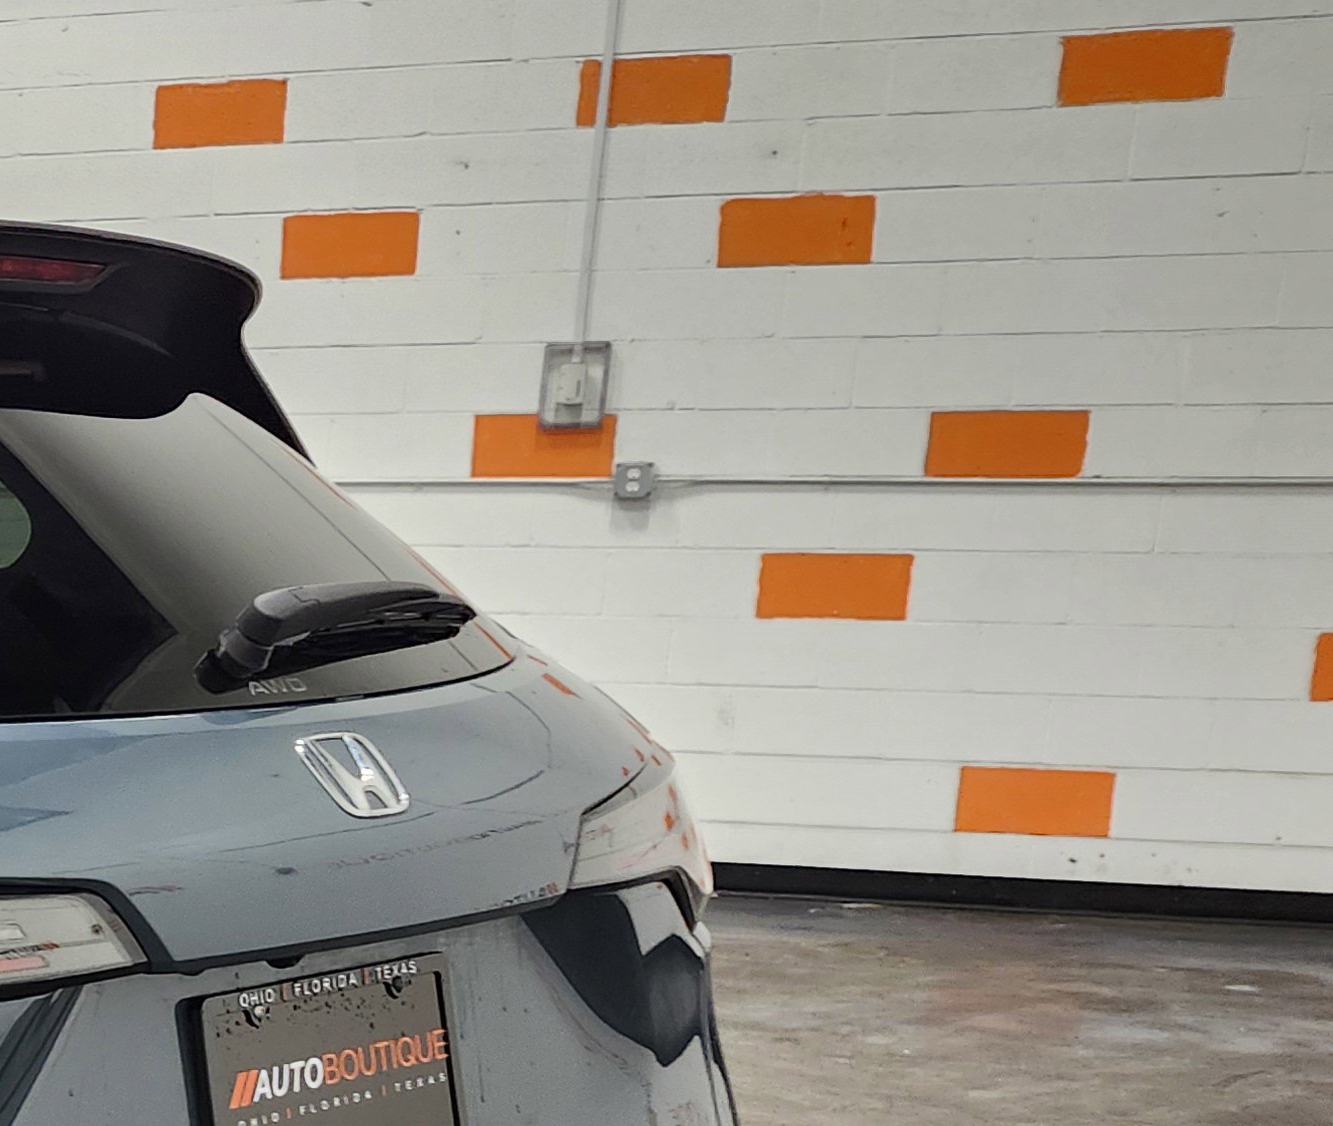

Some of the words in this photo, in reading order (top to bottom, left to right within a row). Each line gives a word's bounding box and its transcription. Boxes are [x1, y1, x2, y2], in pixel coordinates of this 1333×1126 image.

[248, 677, 307, 696] AWD
[238, 987, 276, 1008] OHIO
[292, 972, 359, 998] FLORIDA
[374, 960, 418, 980] TEXAS
[252, 1028, 450, 1103] AUTOBOUTIQUE
[299, 1090, 373, 1116] FLORIDA
[394, 1072, 447, 1093] TEXAS
